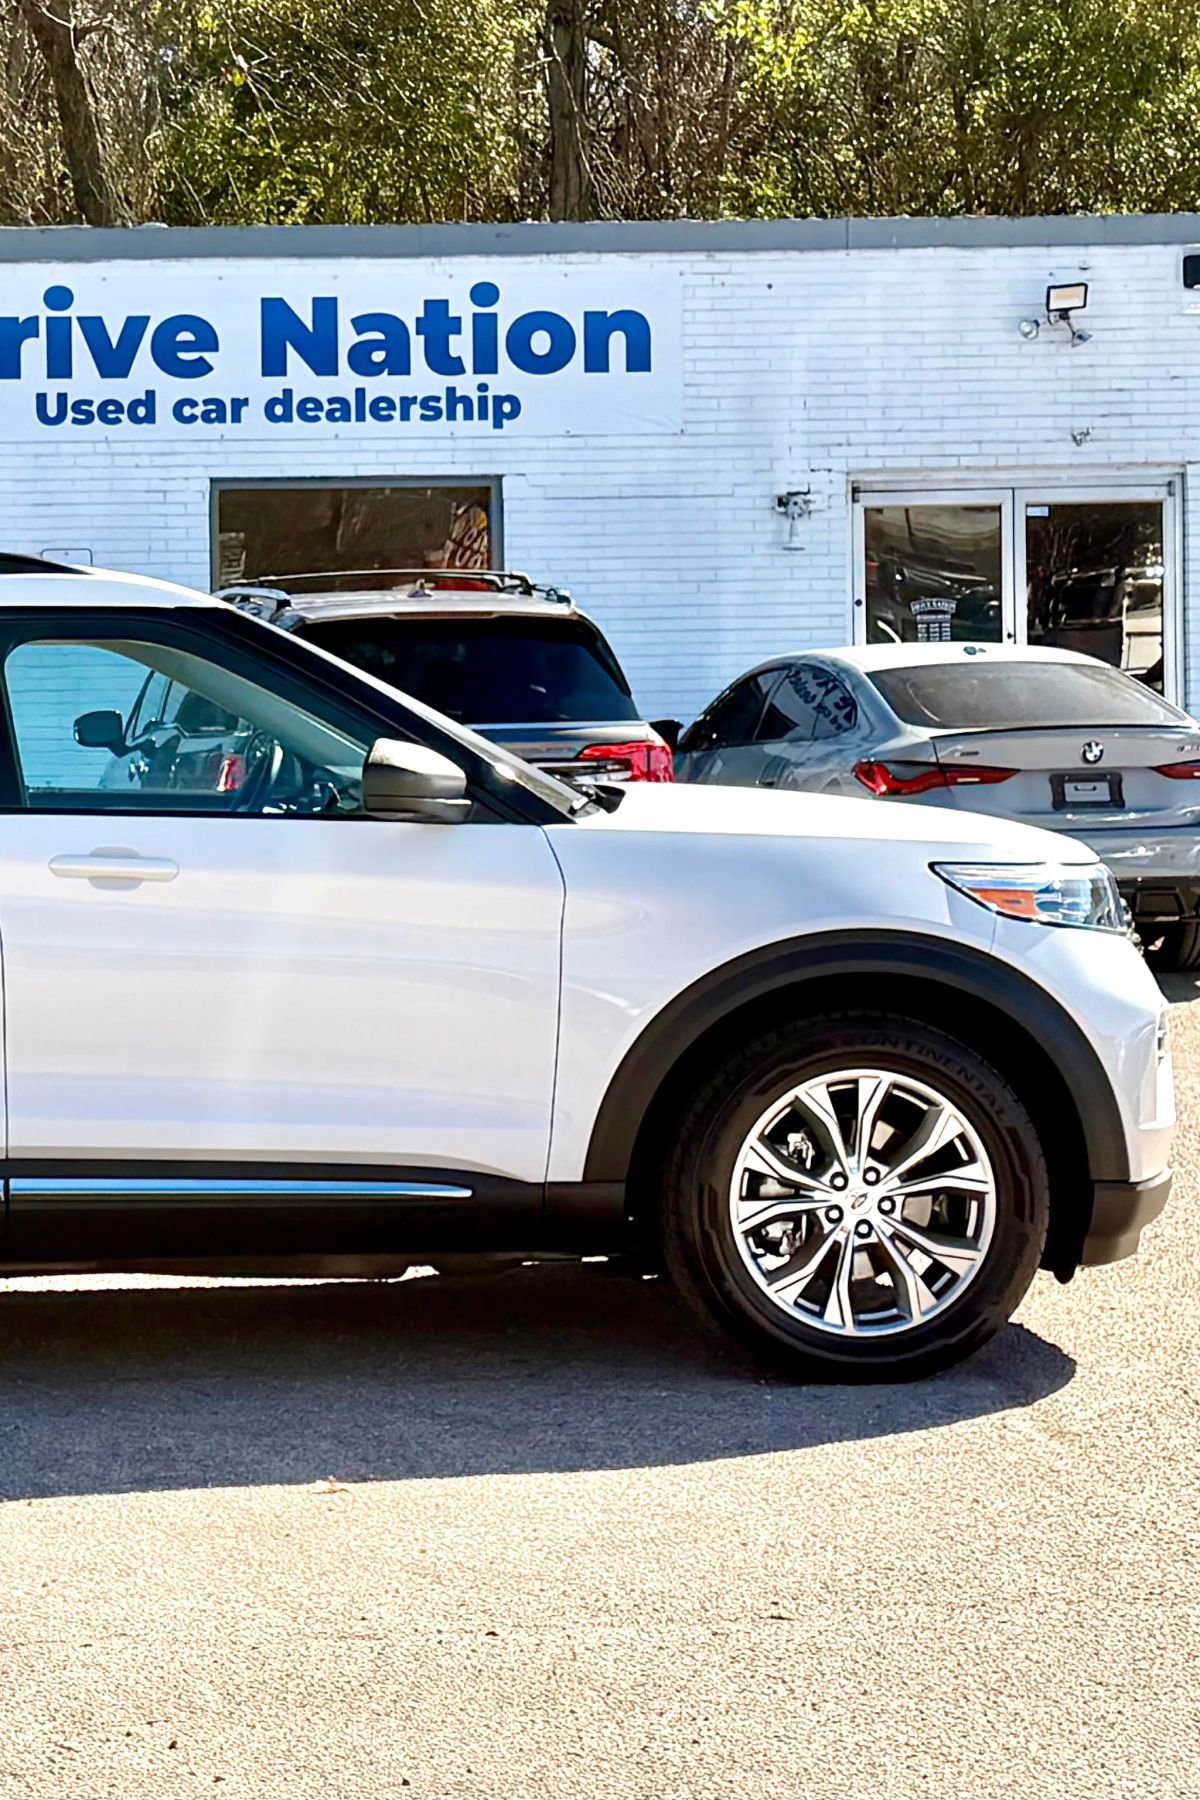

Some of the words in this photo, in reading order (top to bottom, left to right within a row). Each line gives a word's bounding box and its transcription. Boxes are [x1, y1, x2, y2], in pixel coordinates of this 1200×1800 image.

[260, 281, 652, 378] Nation
[35, 389, 157, 427] Used
[172, 396, 250, 426] car
[263, 382, 522, 430] dealership
